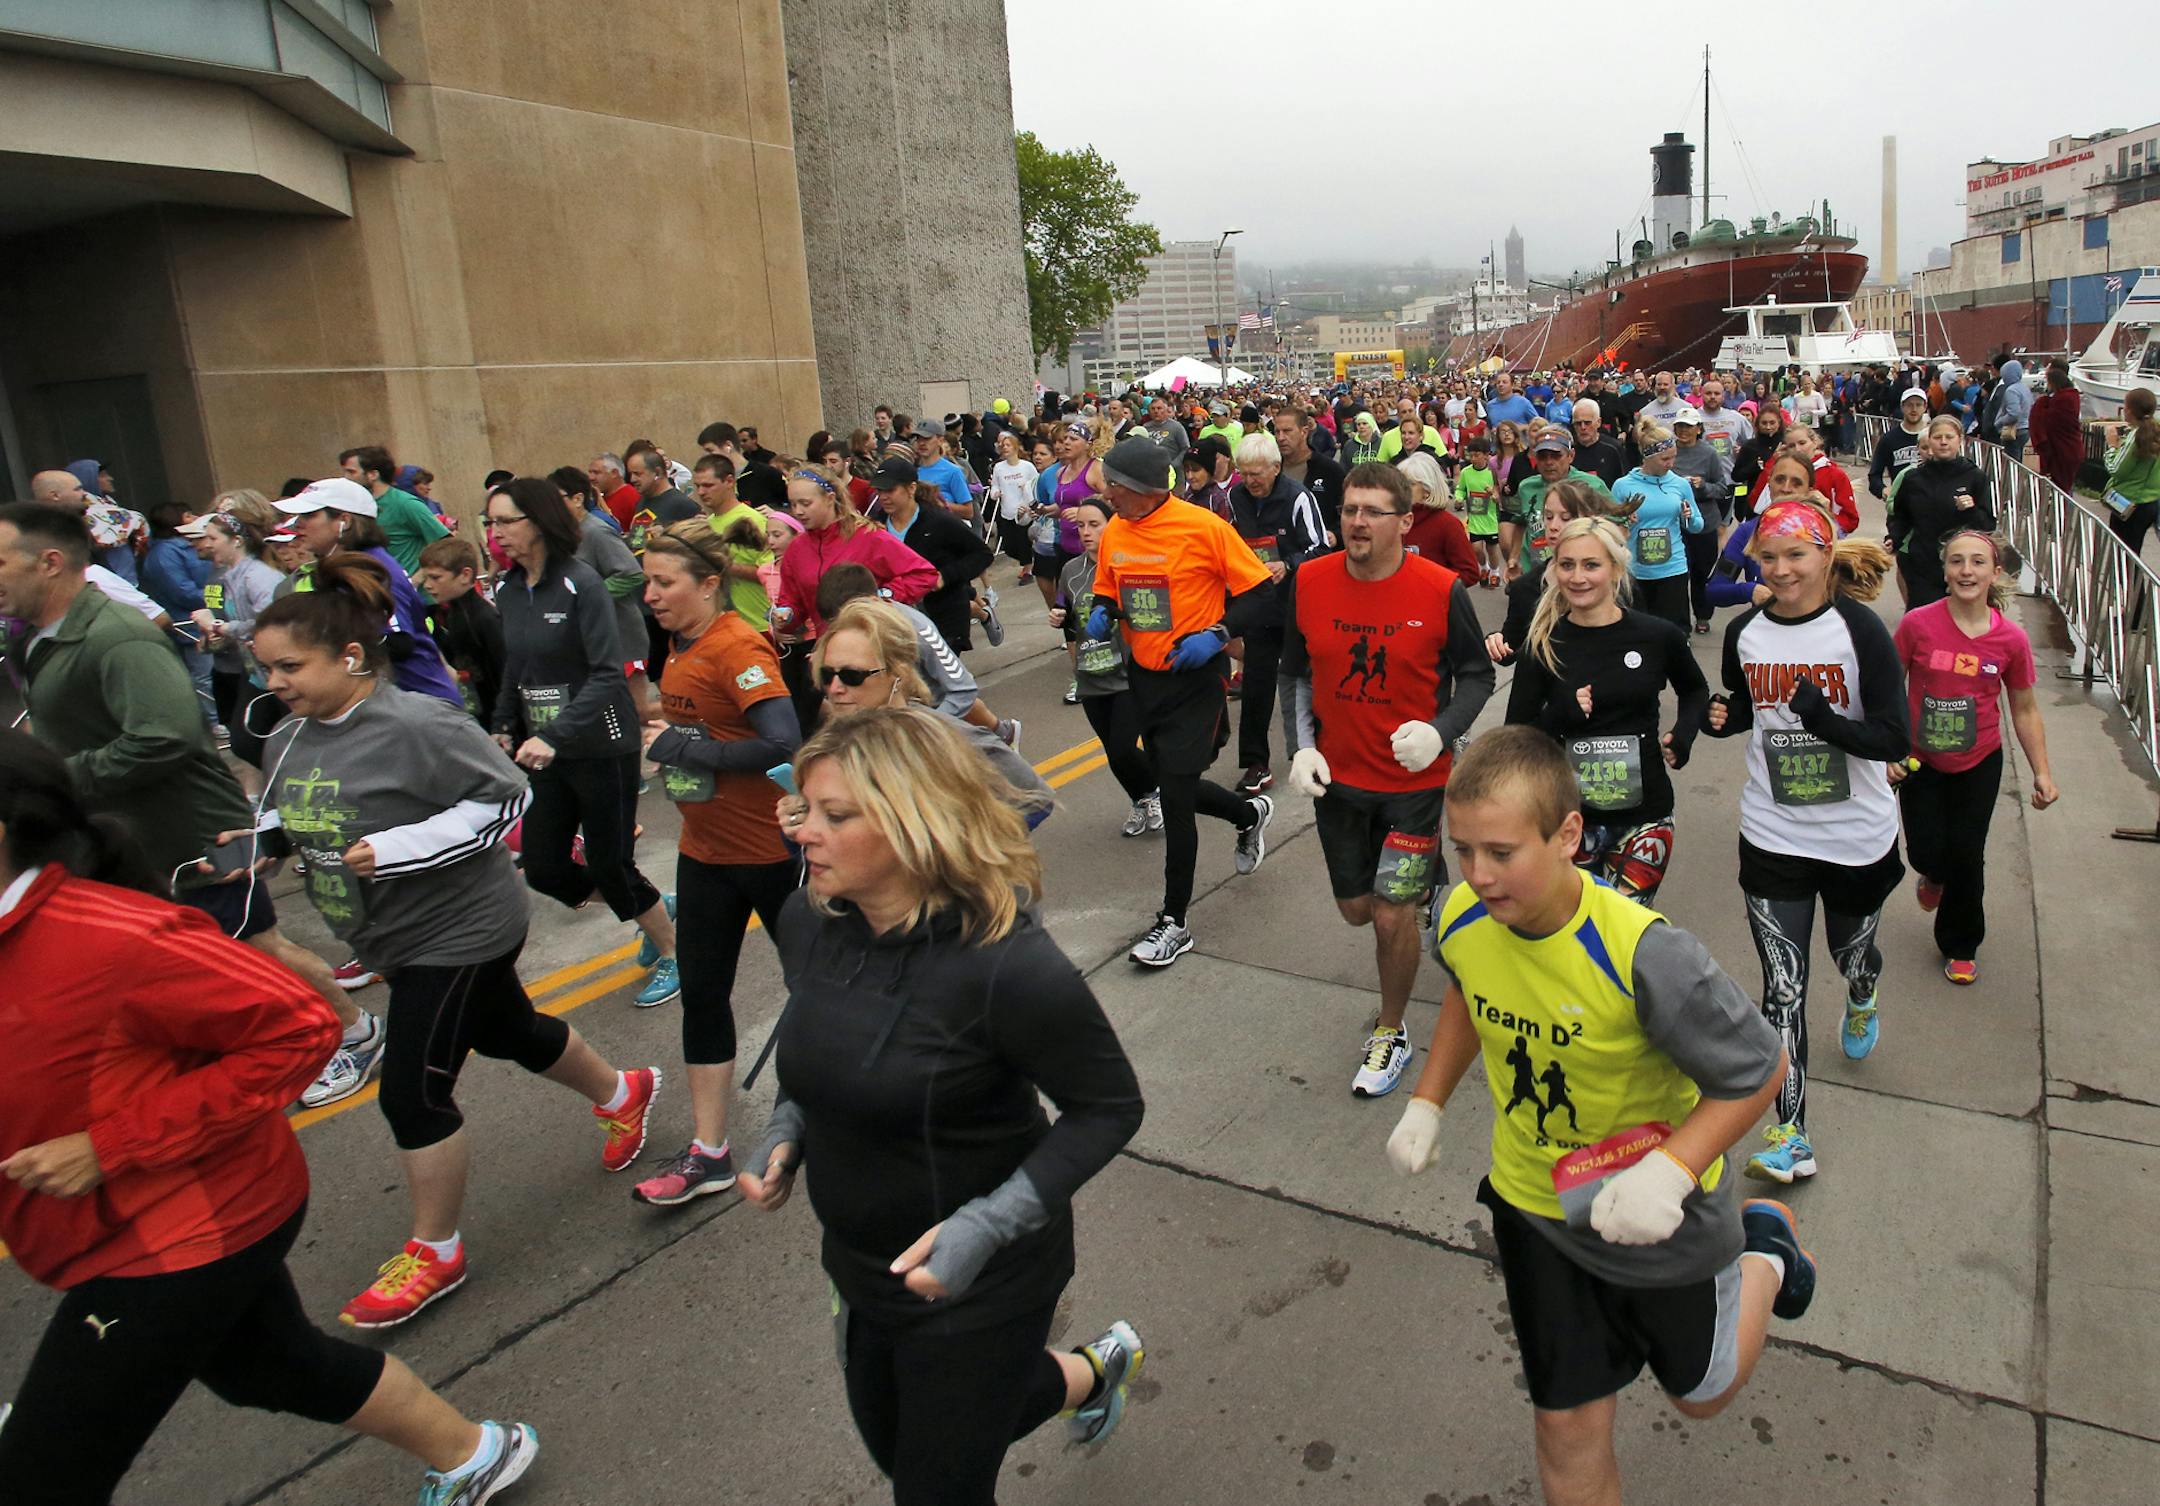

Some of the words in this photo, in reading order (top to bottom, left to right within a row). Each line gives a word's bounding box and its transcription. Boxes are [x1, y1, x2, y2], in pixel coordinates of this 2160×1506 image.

[2012, 163, 2037, 181] HOTEL
[1350, 353, 1387, 361] FINISH
[1333, 619, 1377, 635] Team
[1936, 700, 1968, 709] TOYOTA
[1591, 740, 1629, 749] TOYOTA
[1579, 761, 1628, 782] 2138
[1778, 754, 1830, 777] 2137
[1473, 994, 1540, 1039] Team
[1566, 1149, 1615, 1177] WELLS
[1615, 1131, 1662, 1160] FARGO
